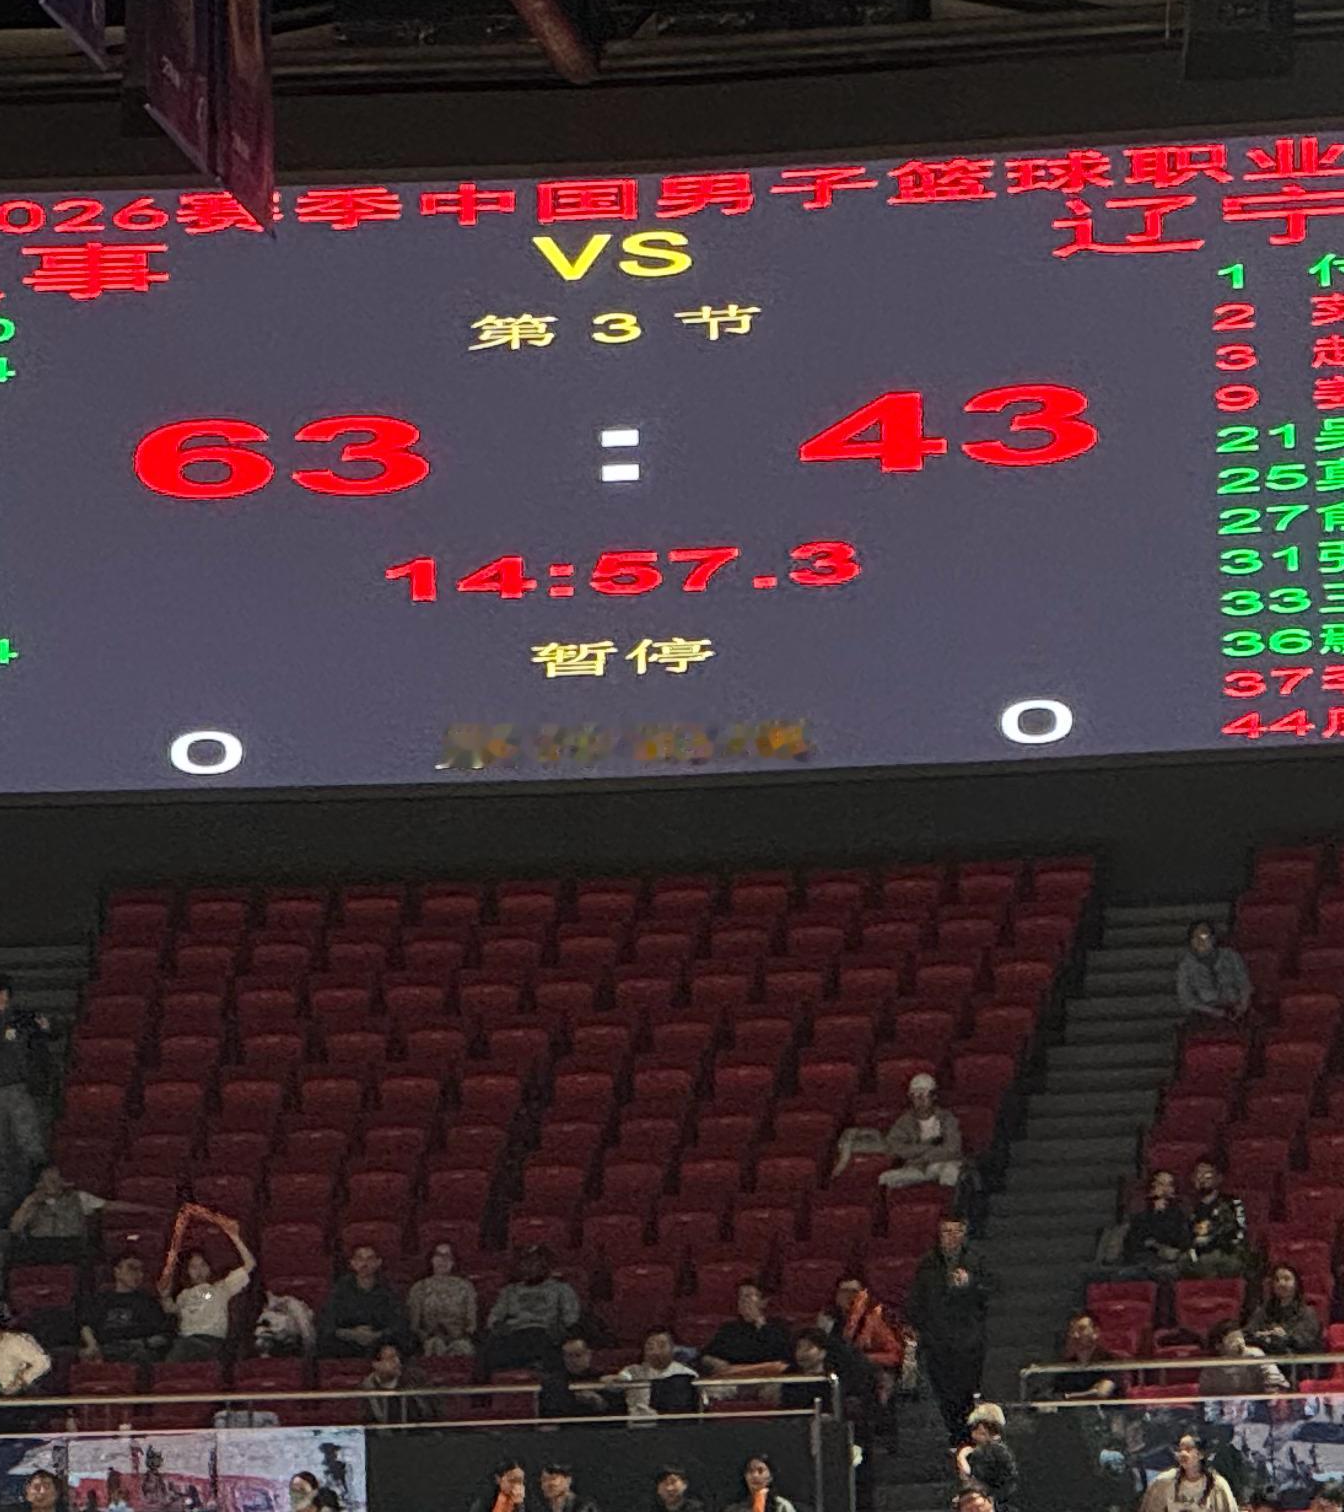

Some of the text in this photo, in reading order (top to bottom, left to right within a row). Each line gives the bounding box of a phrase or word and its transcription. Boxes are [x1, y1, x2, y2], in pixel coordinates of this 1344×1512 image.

[533, 230, 692, 281] VS
[1220, 263, 1246, 288] 1
[1212, 303, 1256, 331] 2
[1215, 343, 1258, 371] 3
[1215, 385, 1259, 412] 9
[134, 415, 430, 501] 63
[799, 384, 1098, 473] 43
[1218, 423, 1296, 453] 21
[1218, 463, 1309, 495] 25
[1219, 504, 1307, 535] 27
[385, 542, 862, 602] 14:57.3
[1221, 545, 1299, 575] 31
[1223, 587, 1312, 616] 33
[530, 635, 717, 679] 暂停
[1222, 628, 1313, 657] 36
[1223, 667, 1312, 698] 37
[1001, 699, 1073, 744] 0
[1221, 709, 1313, 739] 44
[170, 730, 243, 775] 0
